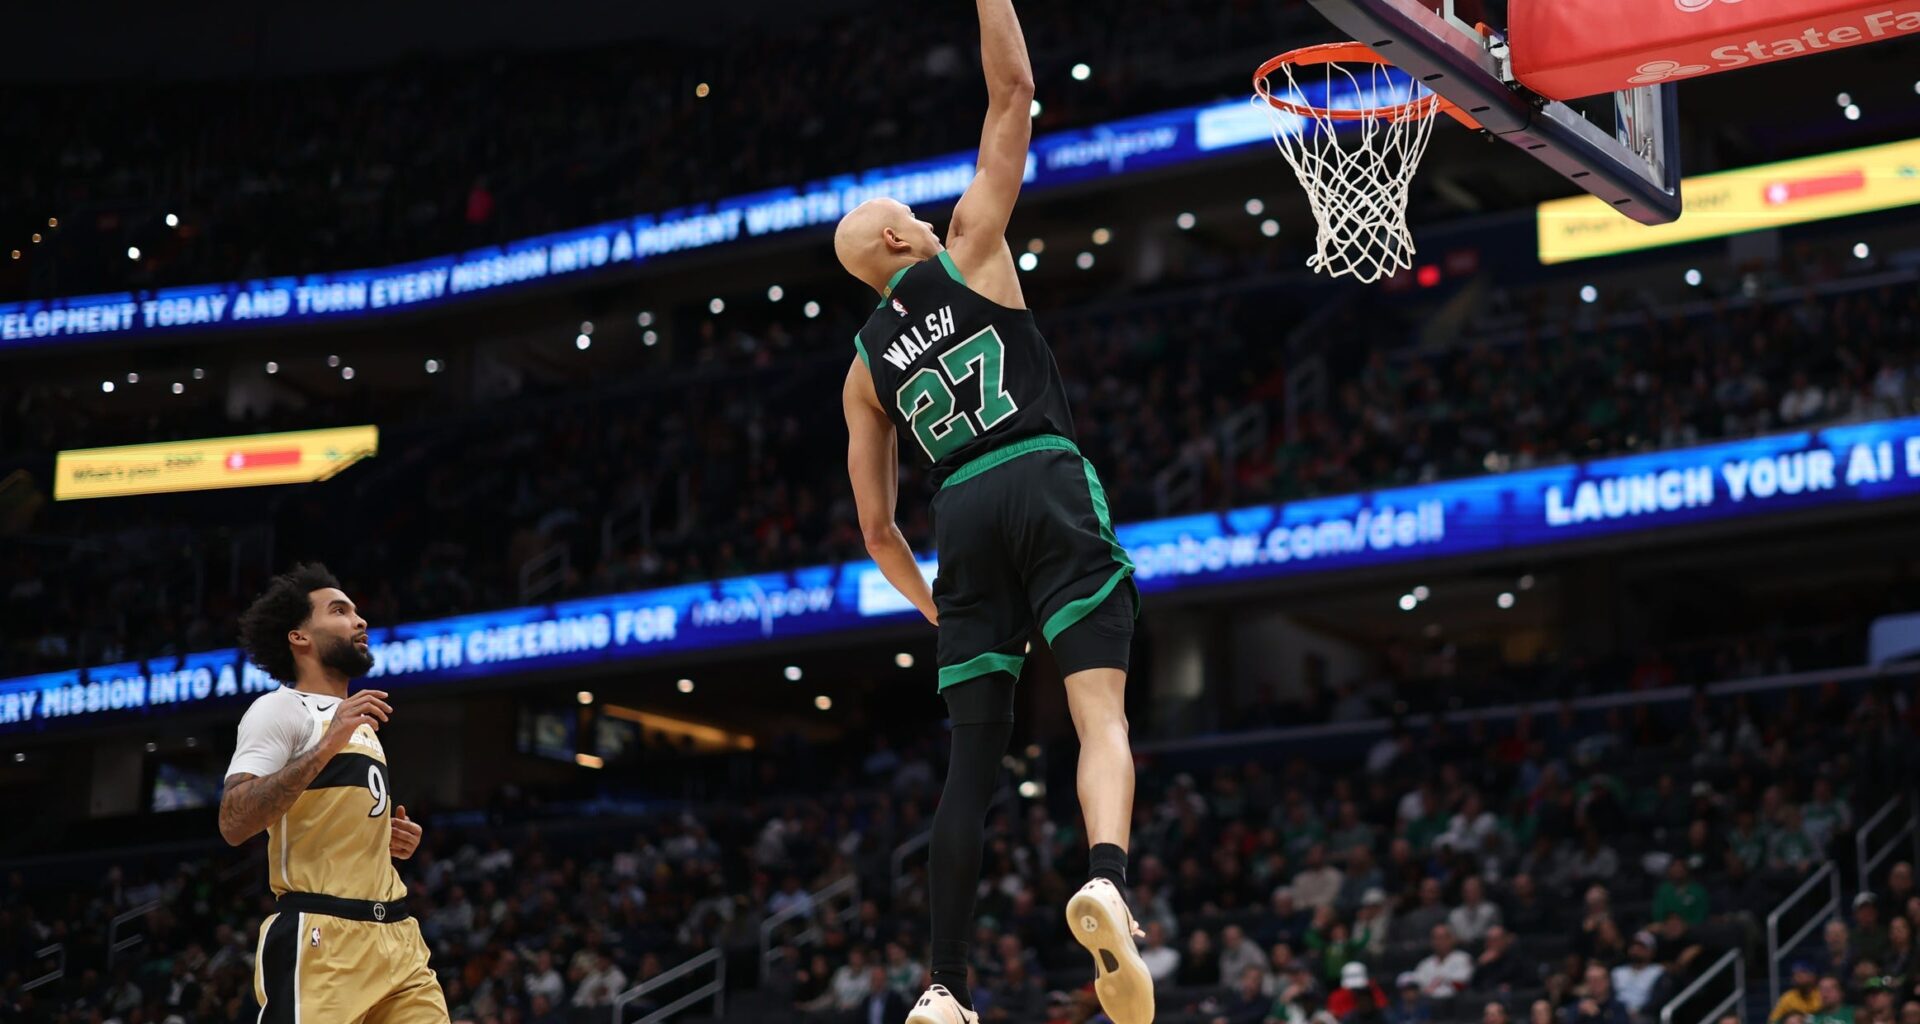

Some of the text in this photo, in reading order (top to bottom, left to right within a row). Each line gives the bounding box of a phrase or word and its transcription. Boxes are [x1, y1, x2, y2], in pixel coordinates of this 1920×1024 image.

[1711, 27, 1862, 67] State
[0, 303, 137, 340] ELOPMENT
[142, 294, 228, 328] TODAY
[231, 288, 290, 321] AND
[296, 280, 366, 314] TURN
[370, 267, 448, 308] EVERY
[450, 246, 547, 294] MISSION
[550, 235, 609, 274] INTO
[612, 230, 632, 262] A
[635, 208, 741, 257] MOMENT
[745, 189, 840, 236] WORTH
[883, 305, 955, 371] WALSH
[896, 324, 1018, 463] 27
[1545, 466, 1713, 526] LAUNCH
[1721, 450, 1835, 502] YOUR
[1845, 440, 1894, 485] AI
[466, 613, 611, 665] CHEERING
[614, 605, 677, 646] FOR
[42, 676, 146, 719] MISSION
[150, 667, 212, 706] INTO
[215, 663, 238, 697] A
[368, 764, 388, 817] 9
